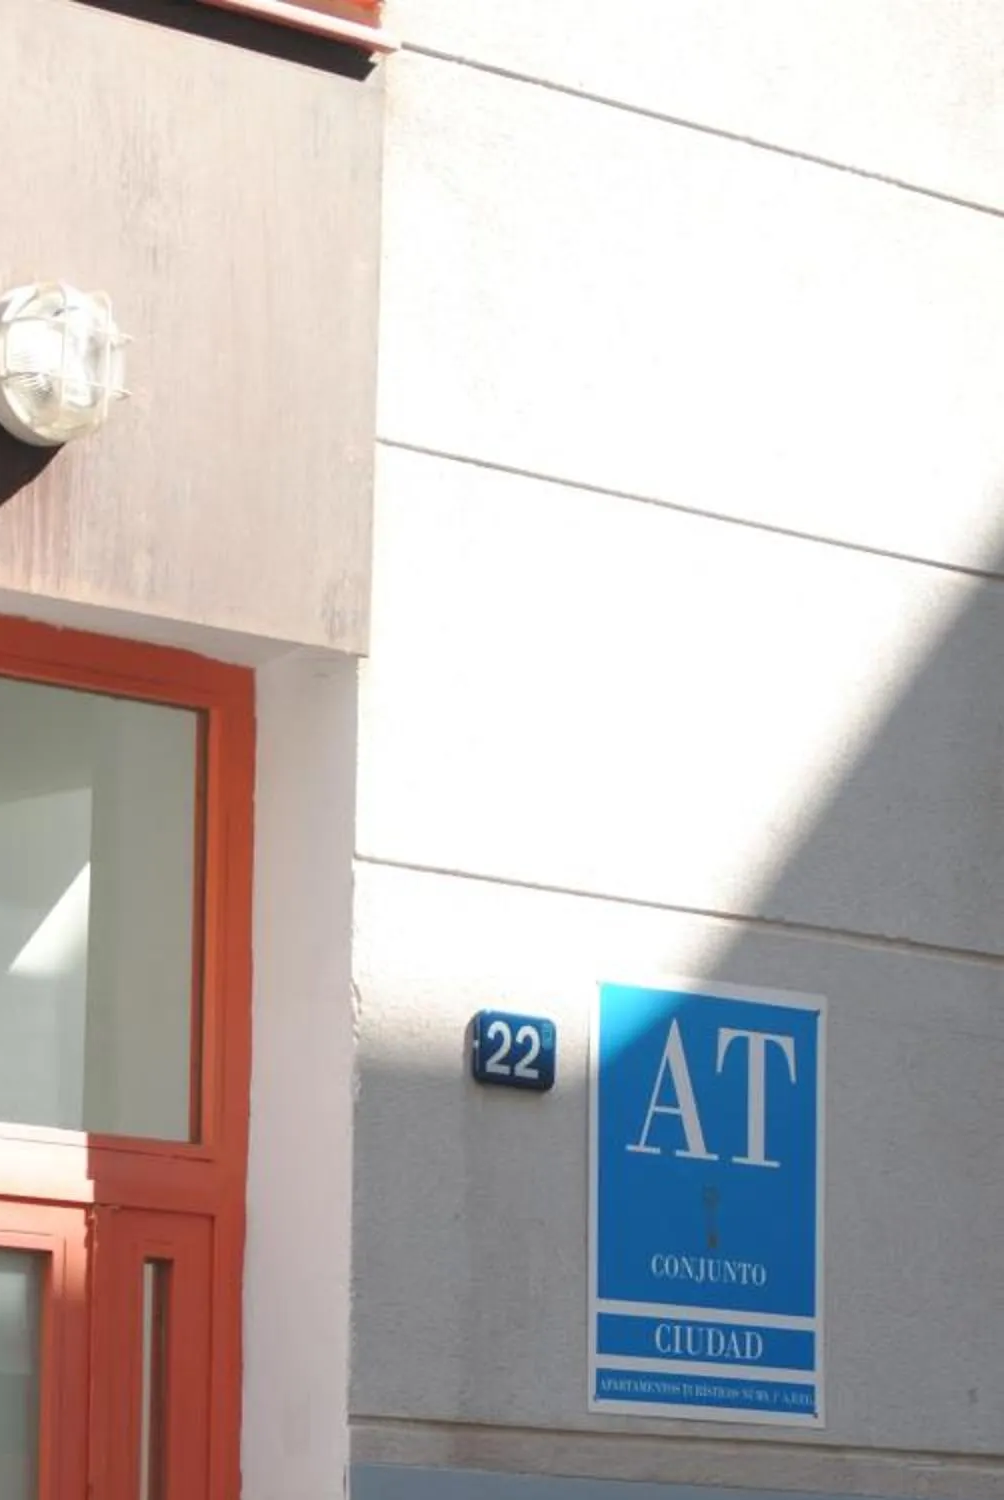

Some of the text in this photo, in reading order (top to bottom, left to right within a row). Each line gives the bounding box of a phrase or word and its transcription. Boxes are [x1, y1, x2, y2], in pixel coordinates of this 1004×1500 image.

[485, 1020, 541, 1079] 22
[626, 1017, 797, 1169] AT
[650, 1252, 767, 1287] CONJUNTO
[654, 1322, 764, 1359] CIUDAD
